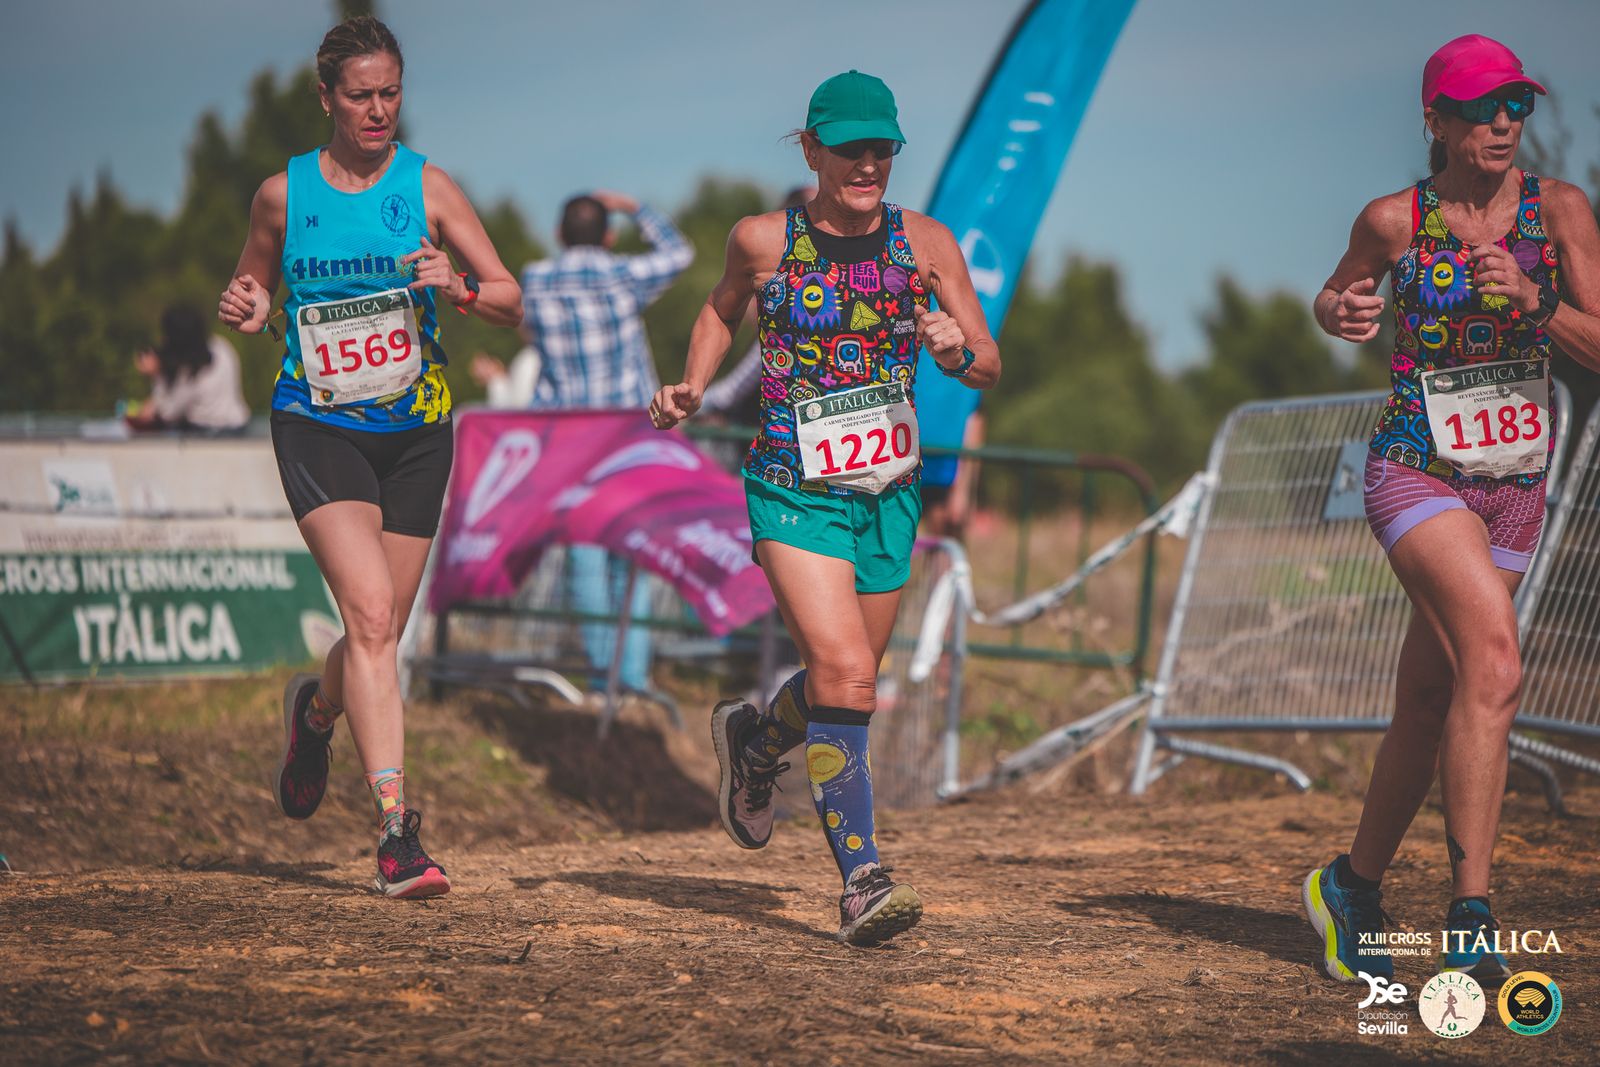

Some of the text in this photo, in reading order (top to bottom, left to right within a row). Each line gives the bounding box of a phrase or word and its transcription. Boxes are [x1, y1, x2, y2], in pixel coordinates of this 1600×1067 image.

[853, 276, 877, 289] RUN
[327, 300, 381, 319] ITÁLICA
[315, 329, 411, 377] 1569
[1461, 367, 1516, 386] ITÁLICA
[830, 392, 882, 411] ITÁLICA
[824, 418, 846, 427] CARMEN
[847, 413, 871, 423] DELGADO
[841, 417, 881, 428] INDEPENDIENTE
[1445, 402, 1542, 450] 1183
[815, 423, 912, 475] 1220
[81, 553, 297, 593] INTERNACIONAL
[73, 592, 243, 664] ITÁLICA
